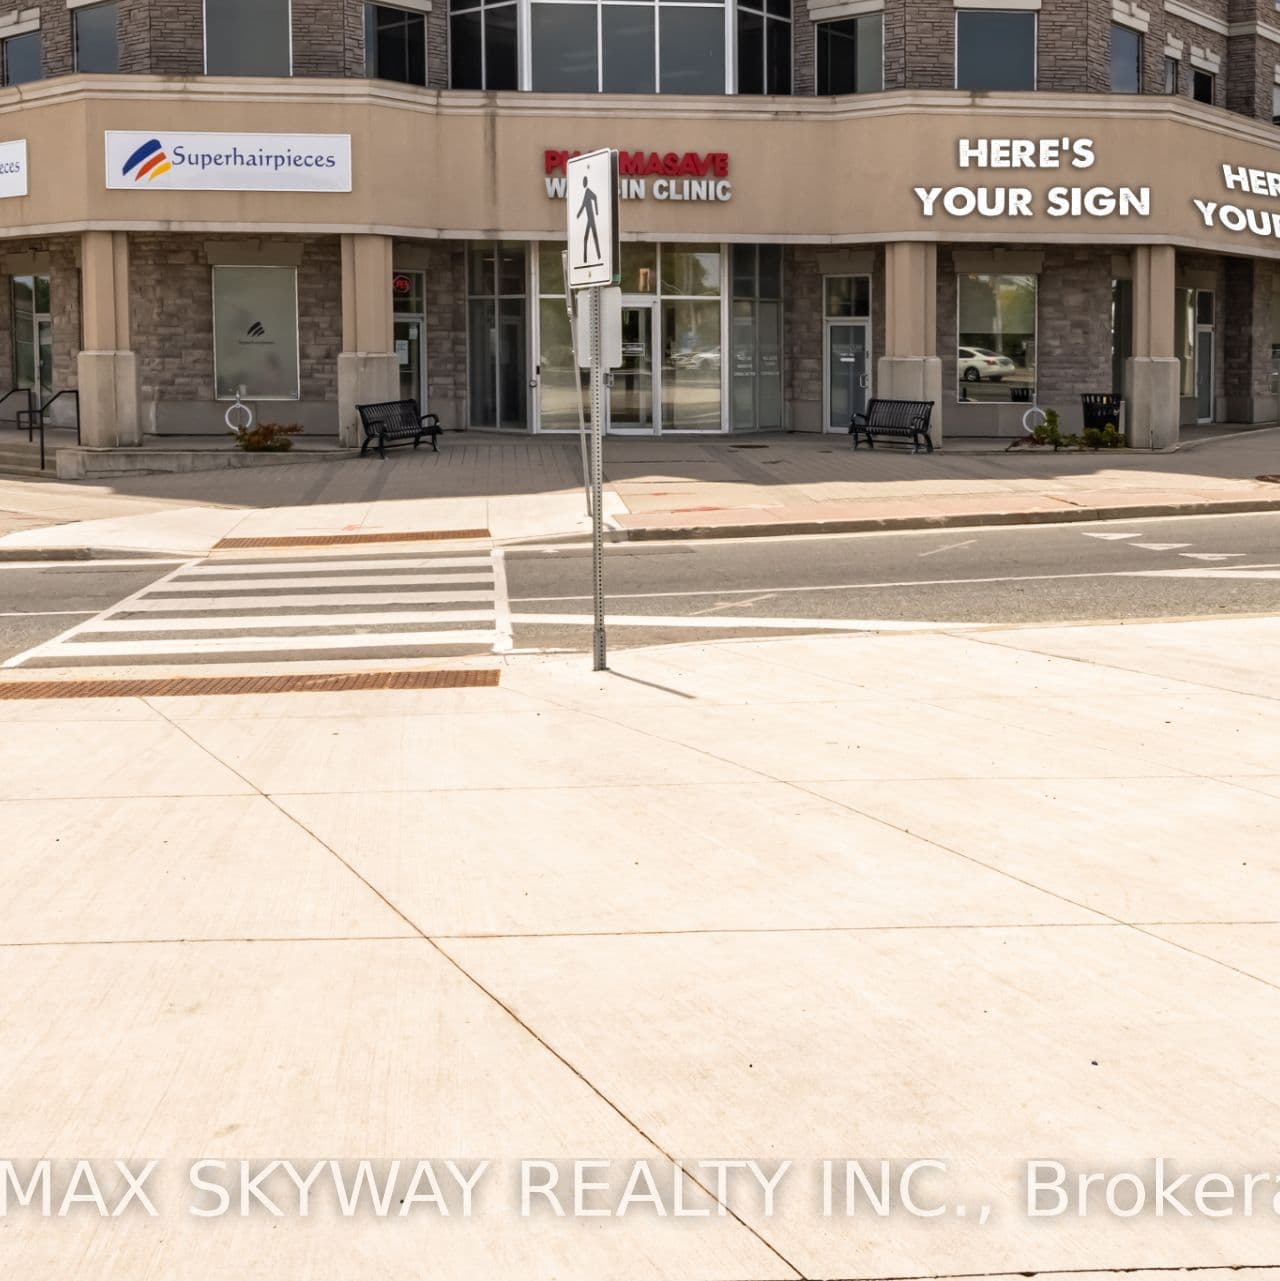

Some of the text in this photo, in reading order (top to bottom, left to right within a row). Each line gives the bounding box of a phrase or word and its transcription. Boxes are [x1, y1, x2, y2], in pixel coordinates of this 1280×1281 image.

[170, 145, 336, 170] Superhairpieces
[958, 138, 1095, 168] HERE'S
[653, 179, 732, 201] CLINIC
[914, 186, 1151, 216] YOUR SIGN
